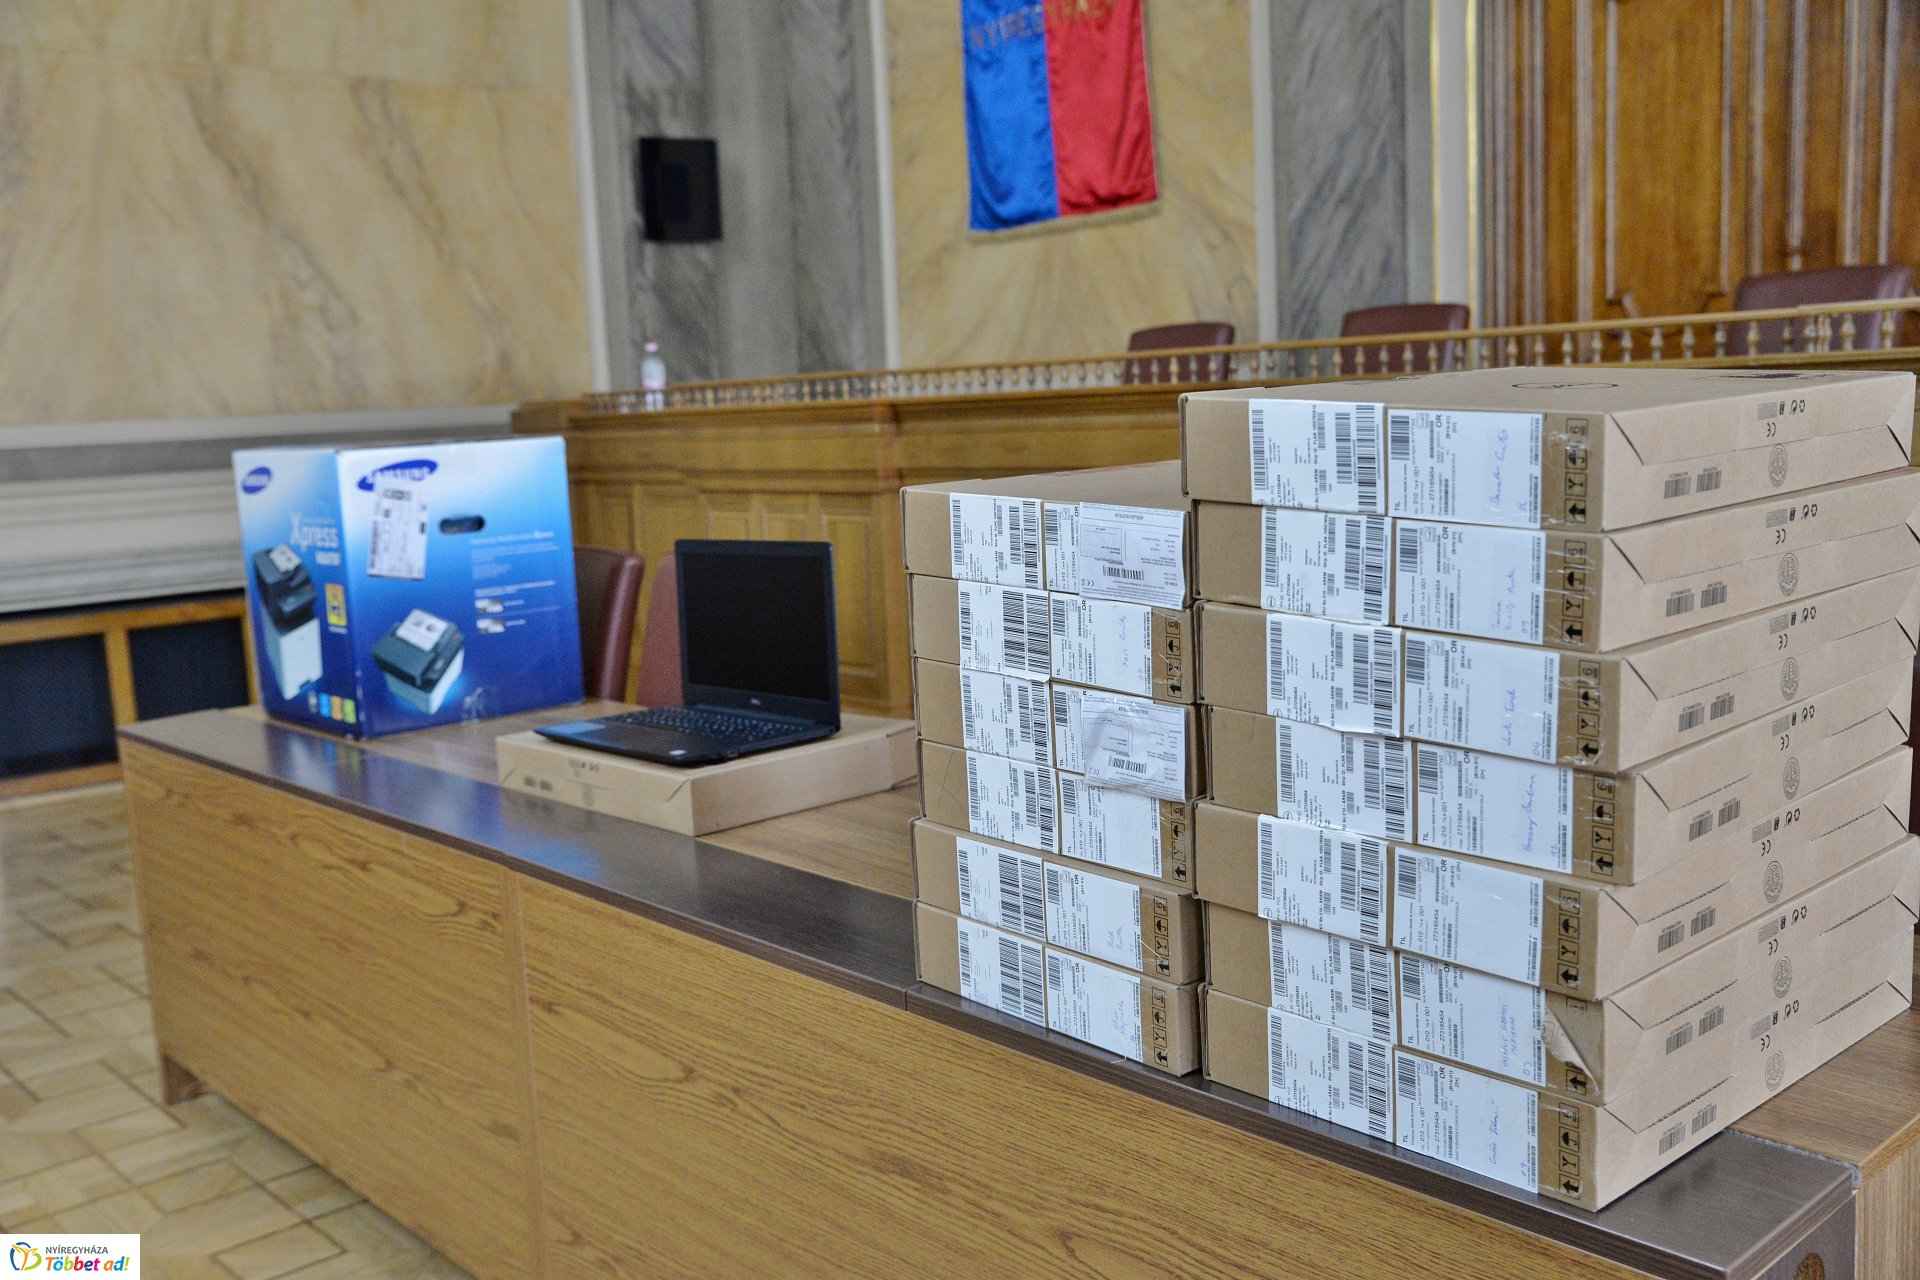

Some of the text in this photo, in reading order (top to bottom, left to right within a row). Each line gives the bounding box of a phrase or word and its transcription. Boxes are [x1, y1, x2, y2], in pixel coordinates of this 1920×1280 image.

[1436, 414, 1441, 427] OR
[1074, 505, 1078, 516] OR
[1442, 526, 1448, 539] OR
[1081, 599, 1086, 610] OR
[1450, 640, 1456, 652] OR
[1464, 750, 1469, 763] OR
[1440, 859, 1446, 871] OR
[1074, 873, 1078, 884] OR
[1075, 962, 1079, 972] OR
[1439, 1066, 1445, 1079] OR
